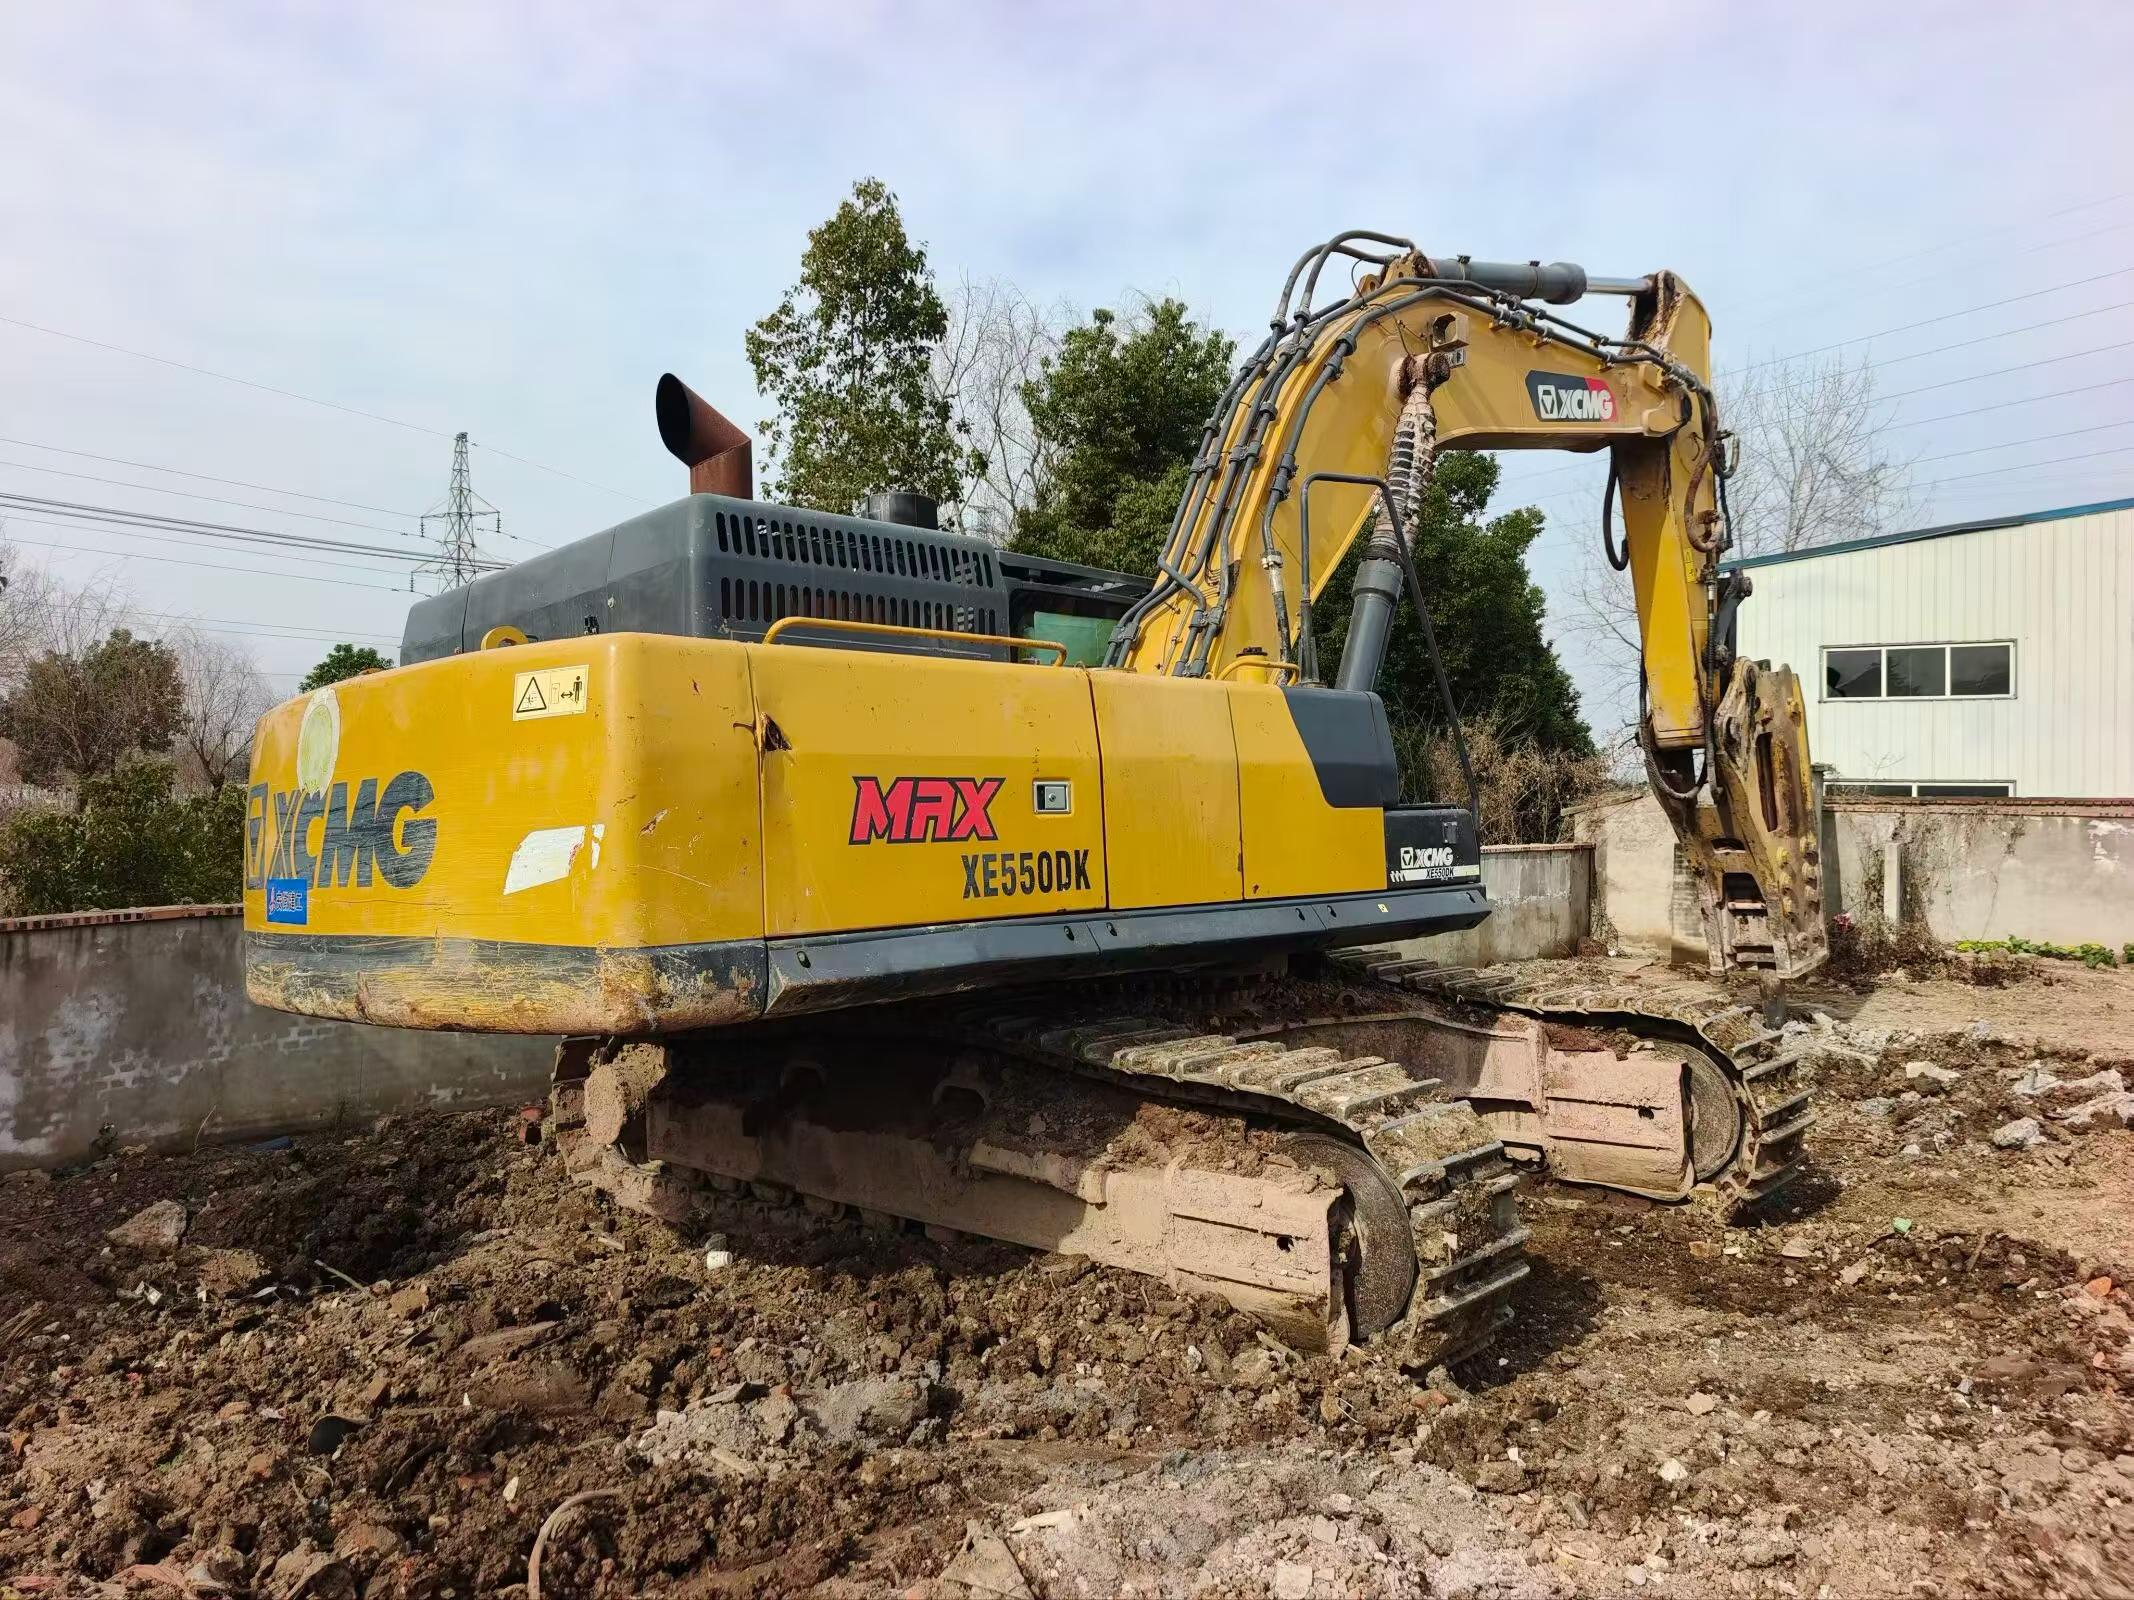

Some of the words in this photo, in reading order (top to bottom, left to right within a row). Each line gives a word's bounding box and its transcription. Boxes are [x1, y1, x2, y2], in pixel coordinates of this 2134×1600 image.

[1557, 389, 1613, 419] XCMG
[266, 770, 438, 889] XCMG
[848, 776, 1006, 845] MAX
[961, 849, 1091, 899] XE550DK
[1413, 847, 1454, 868] XCMG
[1425, 867, 1455, 879] XE550DK
